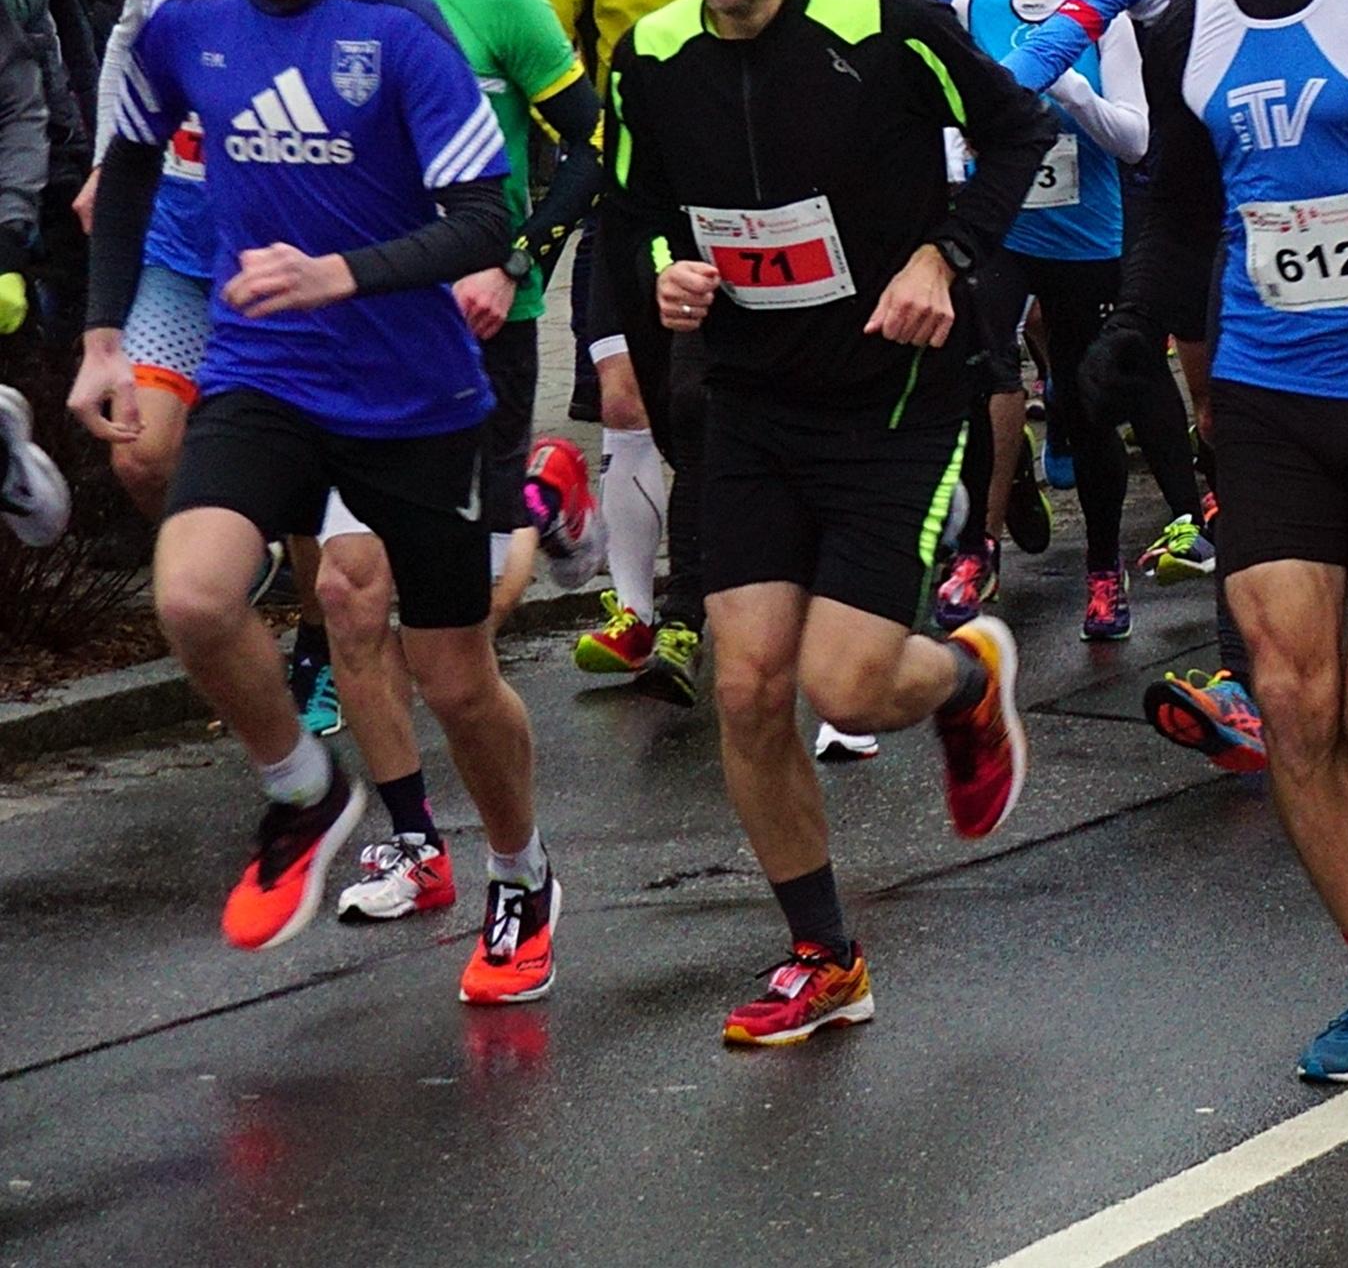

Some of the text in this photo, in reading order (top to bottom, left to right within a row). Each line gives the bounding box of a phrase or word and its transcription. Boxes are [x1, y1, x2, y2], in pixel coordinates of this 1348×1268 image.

[1227, 78, 1328, 150] TV
[225, 130, 355, 165] adidas
[739, 251, 797, 283] 71
